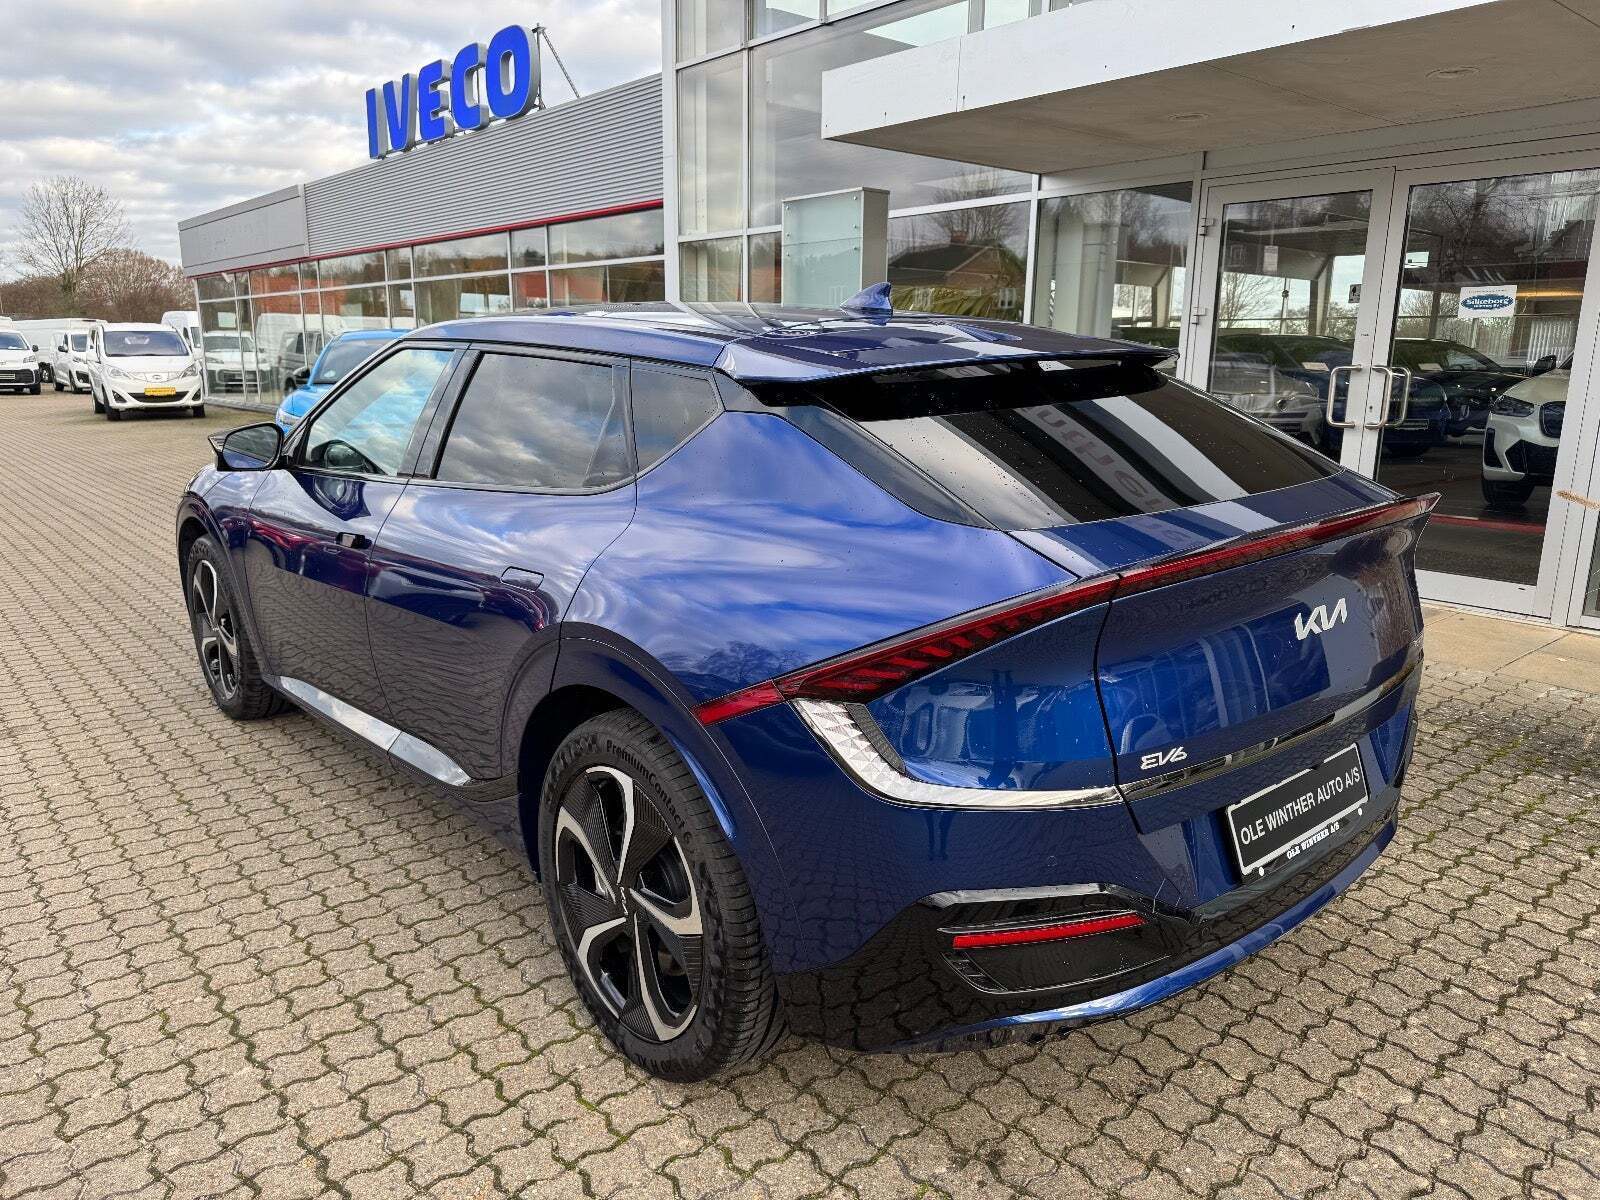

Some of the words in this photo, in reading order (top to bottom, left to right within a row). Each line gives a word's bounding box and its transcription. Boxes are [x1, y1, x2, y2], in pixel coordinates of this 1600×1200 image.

[365, 24, 540, 160] IVECO
[1293, 597, 1348, 641] KIA
[606, 739, 686, 830] PremiumContact
[1139, 746, 1188, 770] EV6
[1240, 818, 1266, 845] OLE
[1265, 792, 1316, 832] WINTHER
[1317, 776, 1344, 804] AUTO
[1345, 766, 1360, 789] A/S
[1286, 843, 1301, 859] OLE
[1301, 828, 1330, 850] WINTHER
[1330, 821, 1340, 834] A/S
